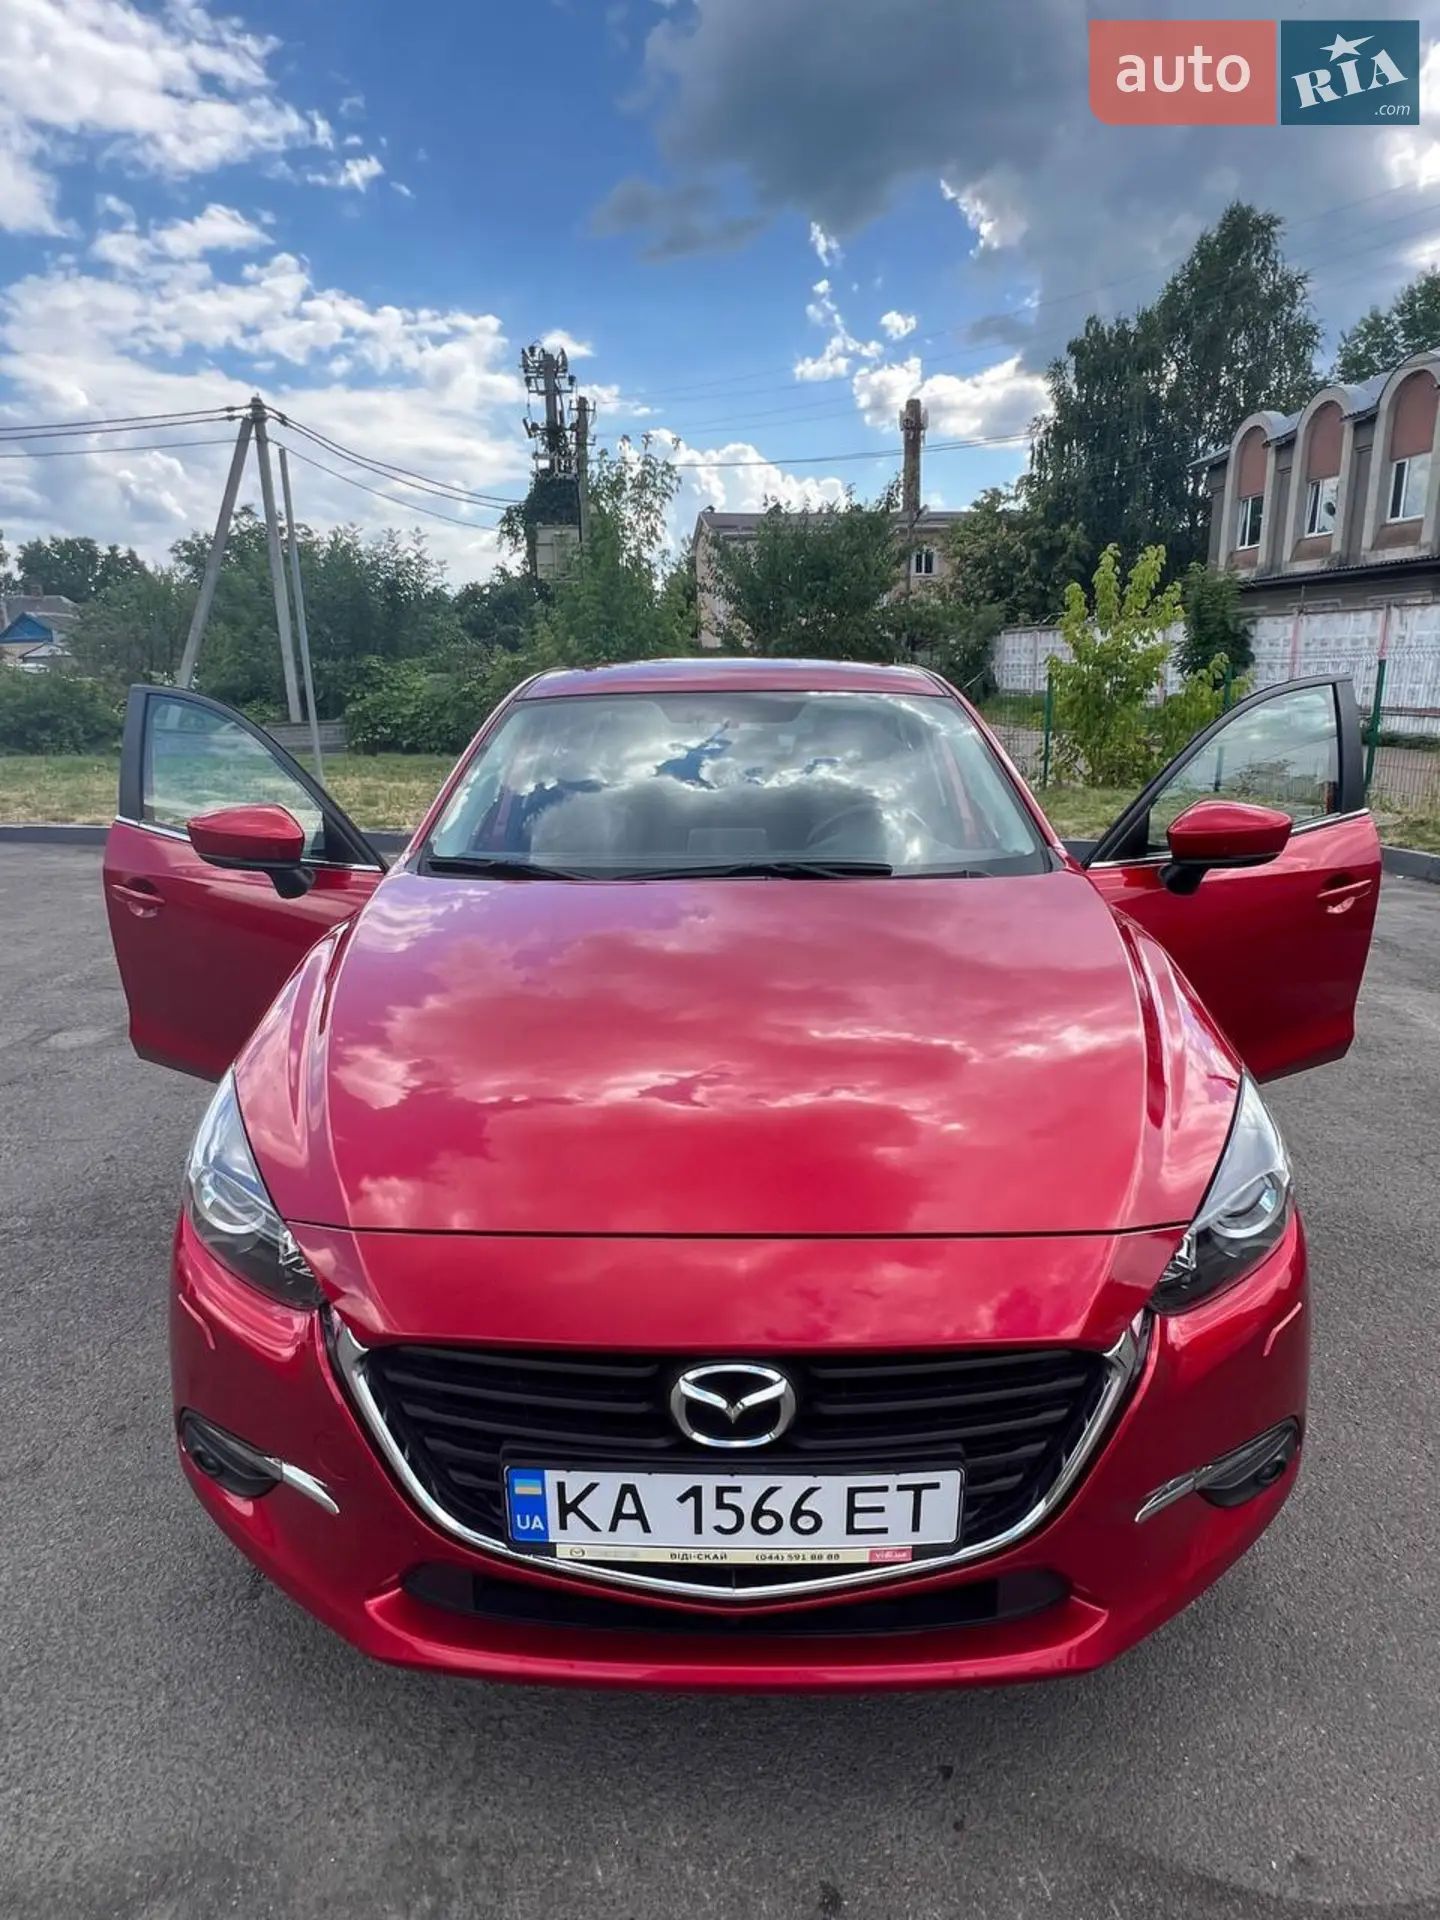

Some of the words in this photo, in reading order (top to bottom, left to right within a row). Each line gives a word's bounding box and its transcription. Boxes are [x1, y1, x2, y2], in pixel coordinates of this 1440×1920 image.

[556, 1481, 652, 1534] KA
[676, 1485, 823, 1536] 1566
[845, 1482, 941, 1536] ET
[516, 1514, 545, 1531] UA
[755, 1553, 785, 1562] (044)
